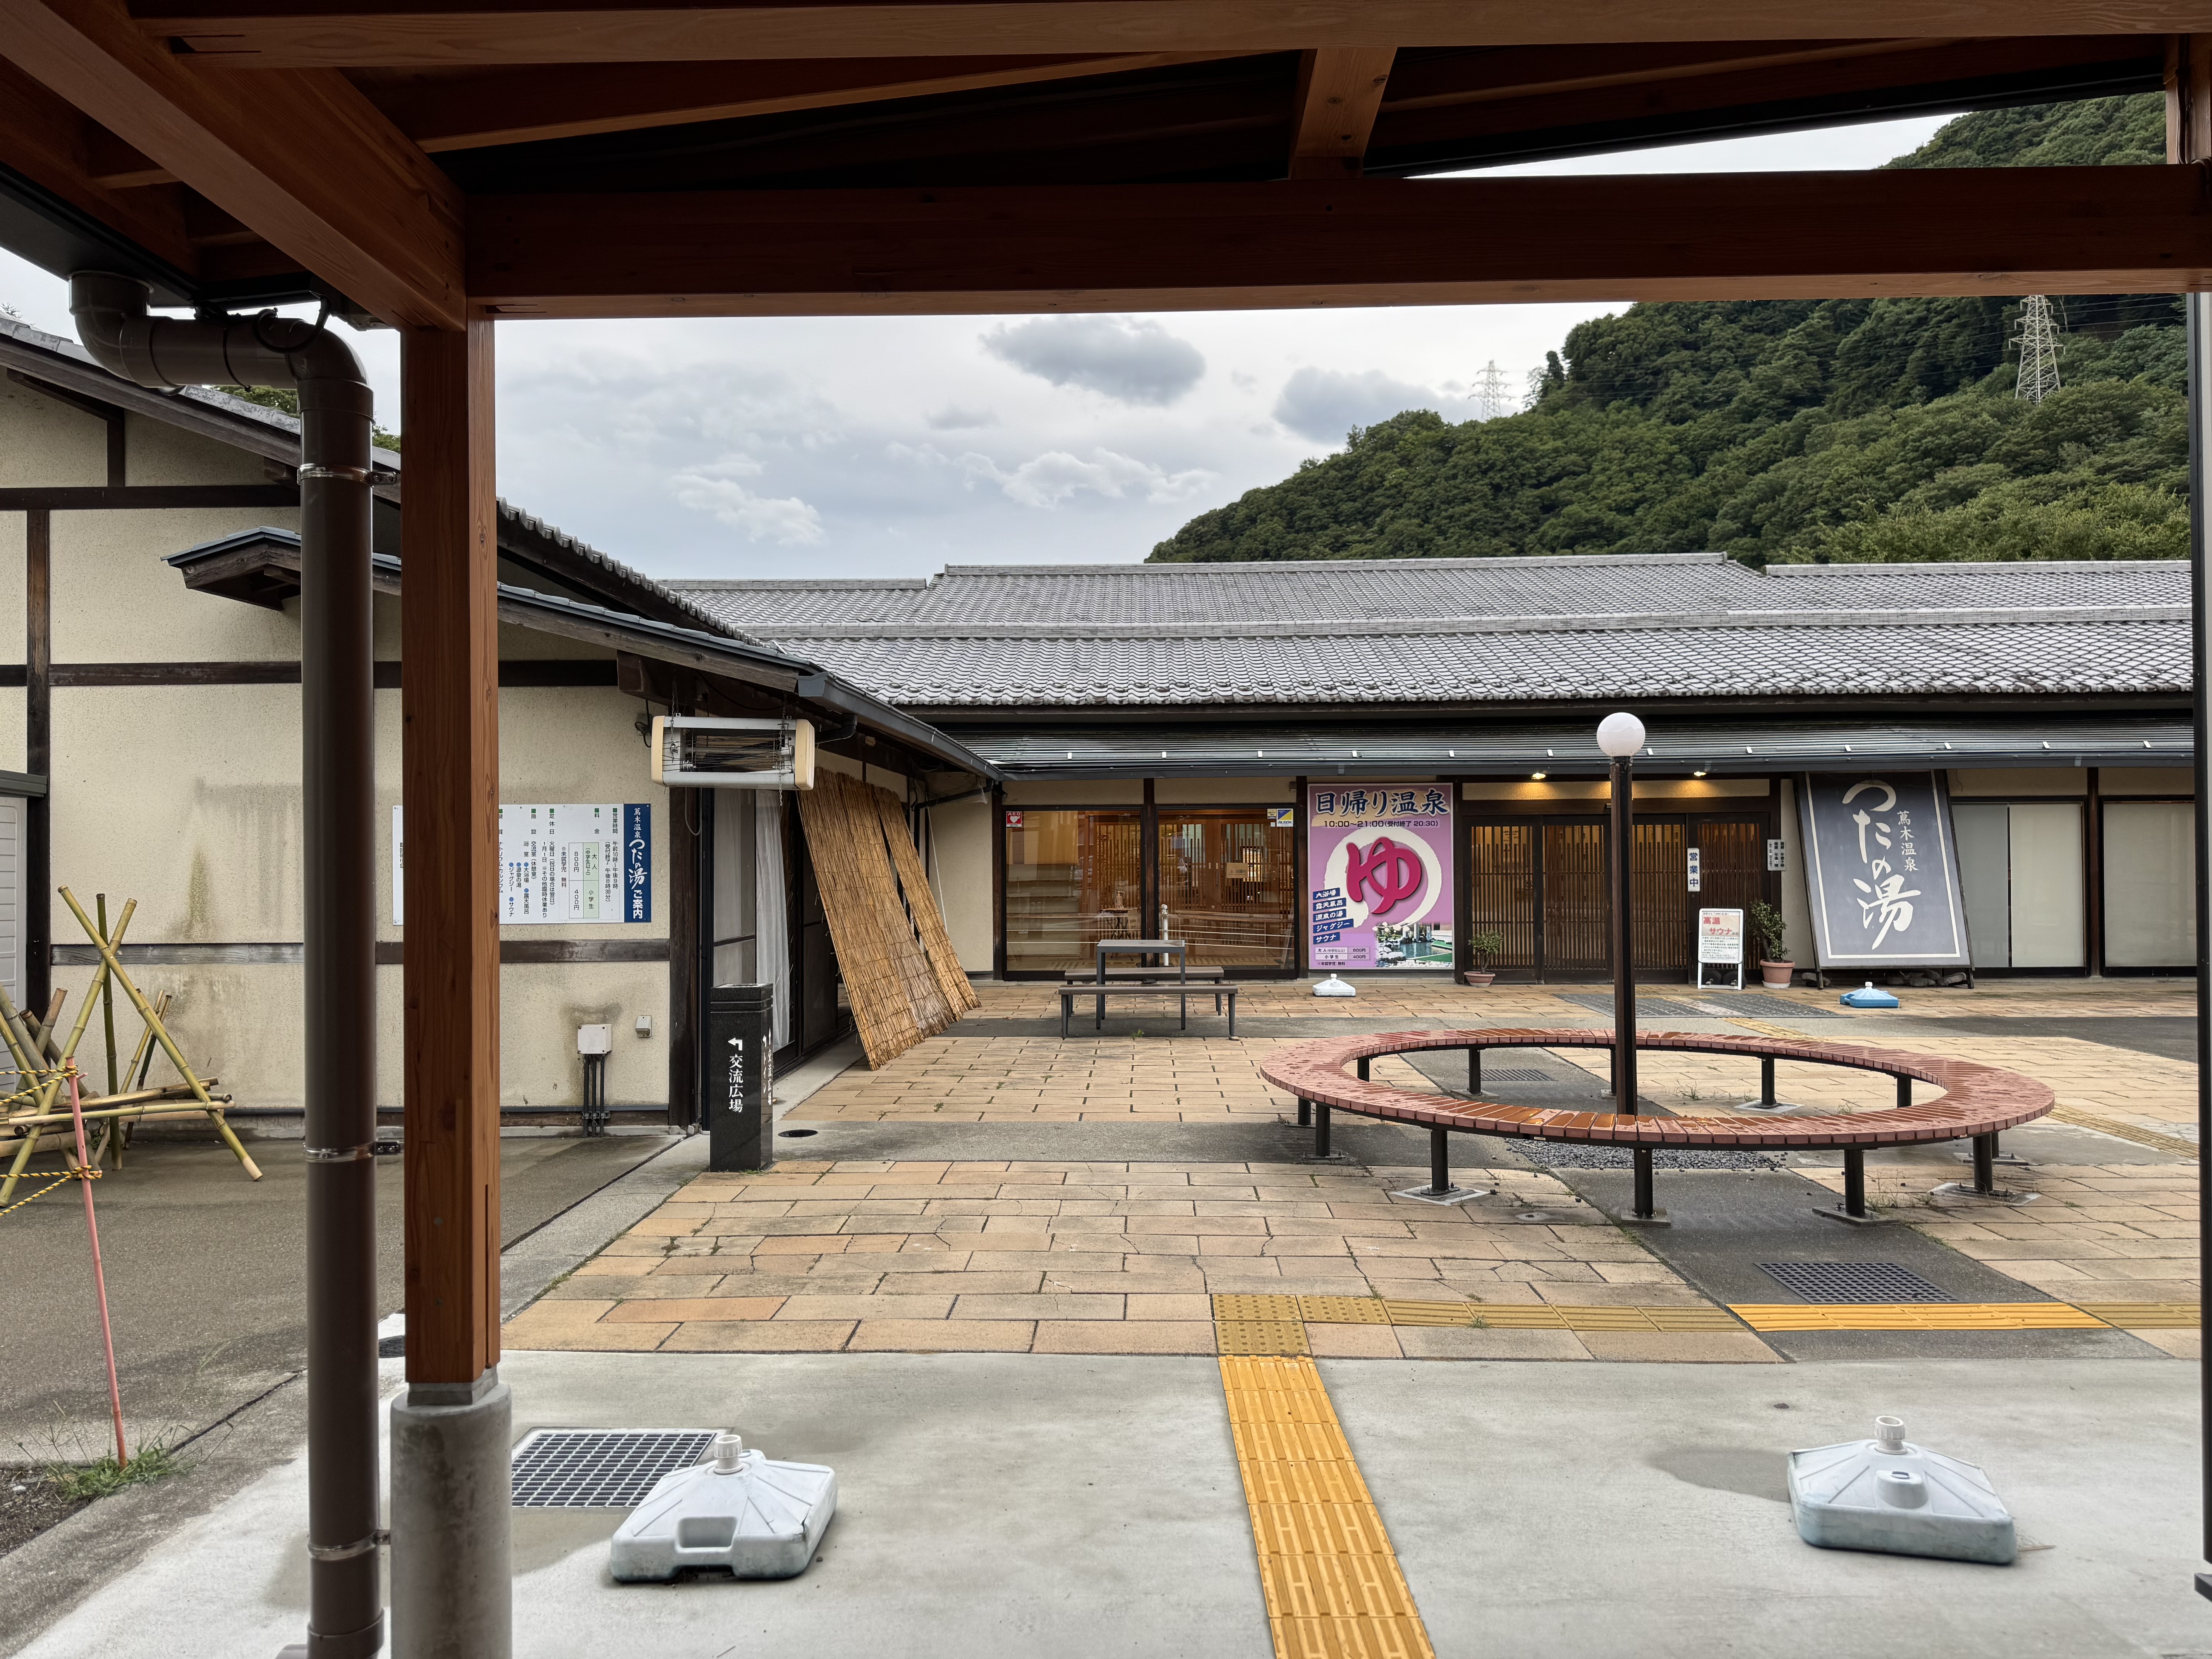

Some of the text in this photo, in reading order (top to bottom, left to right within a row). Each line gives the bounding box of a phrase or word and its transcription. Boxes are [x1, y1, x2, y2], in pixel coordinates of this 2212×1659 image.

[1317, 788, 1449, 816] 日帰り温泉
[531, 814, 536, 834] 施設
[594, 813, 599, 834] 料金
[1897, 810, 1918, 872] 蔦木温泉
[592, 854, 597, 869] 大人
[629, 839, 647, 890] つたの湯
[1346, 836, 1422, 914] ゆ
[1689, 852, 1698, 887] 営業中
[1842, 780, 1921, 950] つたの湯
[633, 890, 643, 919] ご案内
[1316, 890, 1336, 898] 大浴場
[1316, 900, 1343, 910] 露天風呂
[1316, 910, 1343, 921] 源泉の湯
[1316, 934, 1336, 943] サウナ
[728, 1054, 743, 1113] 交流広場
